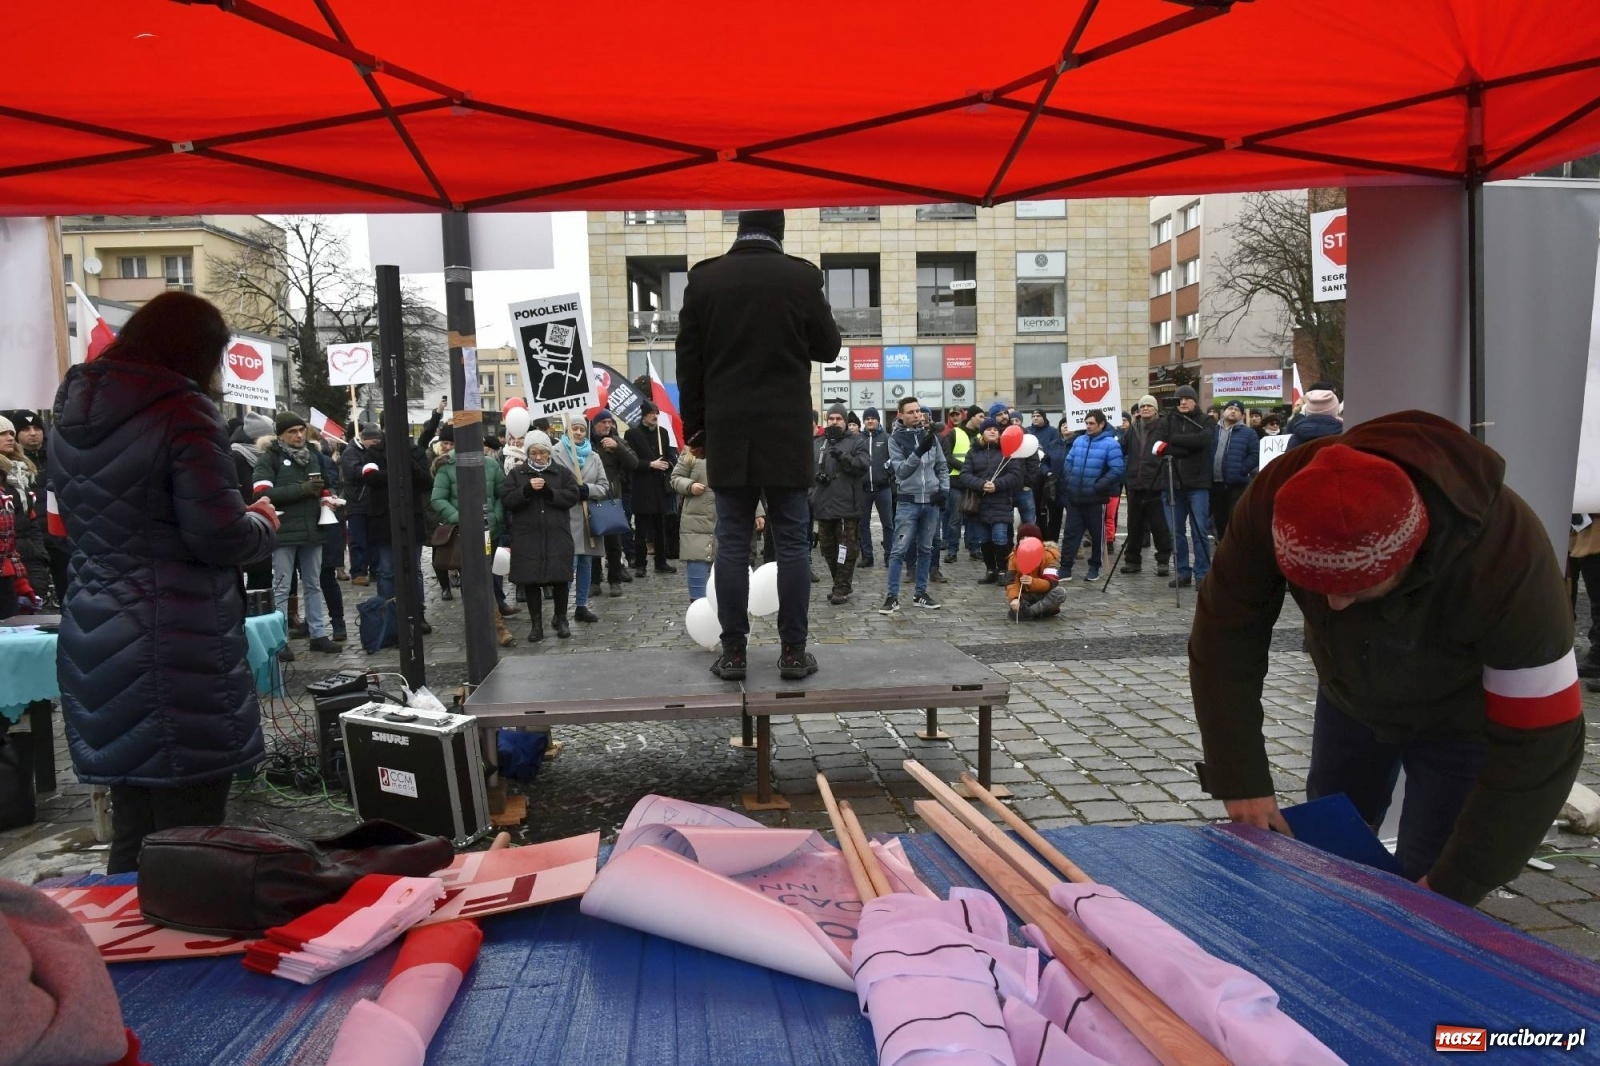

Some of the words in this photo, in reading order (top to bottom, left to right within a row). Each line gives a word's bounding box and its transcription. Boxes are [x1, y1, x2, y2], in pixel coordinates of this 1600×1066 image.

[1323, 232, 1346, 249] ST
[1321, 273, 1347, 282] SEGR
[1321, 283, 1347, 292] SANIT
[514, 302, 578, 320] POKOLENIE
[229, 353, 262, 369] STOP
[227, 383, 270, 394] PASZPORTOM
[1072, 376, 1108, 391] STOP
[229, 391, 269, 401] COVIDOWYM
[1264, 438, 1285, 453] WYŁ
[371, 731, 410, 746] SHURE
[390, 771, 413, 785] CCM
[392, 782, 415, 792] media
